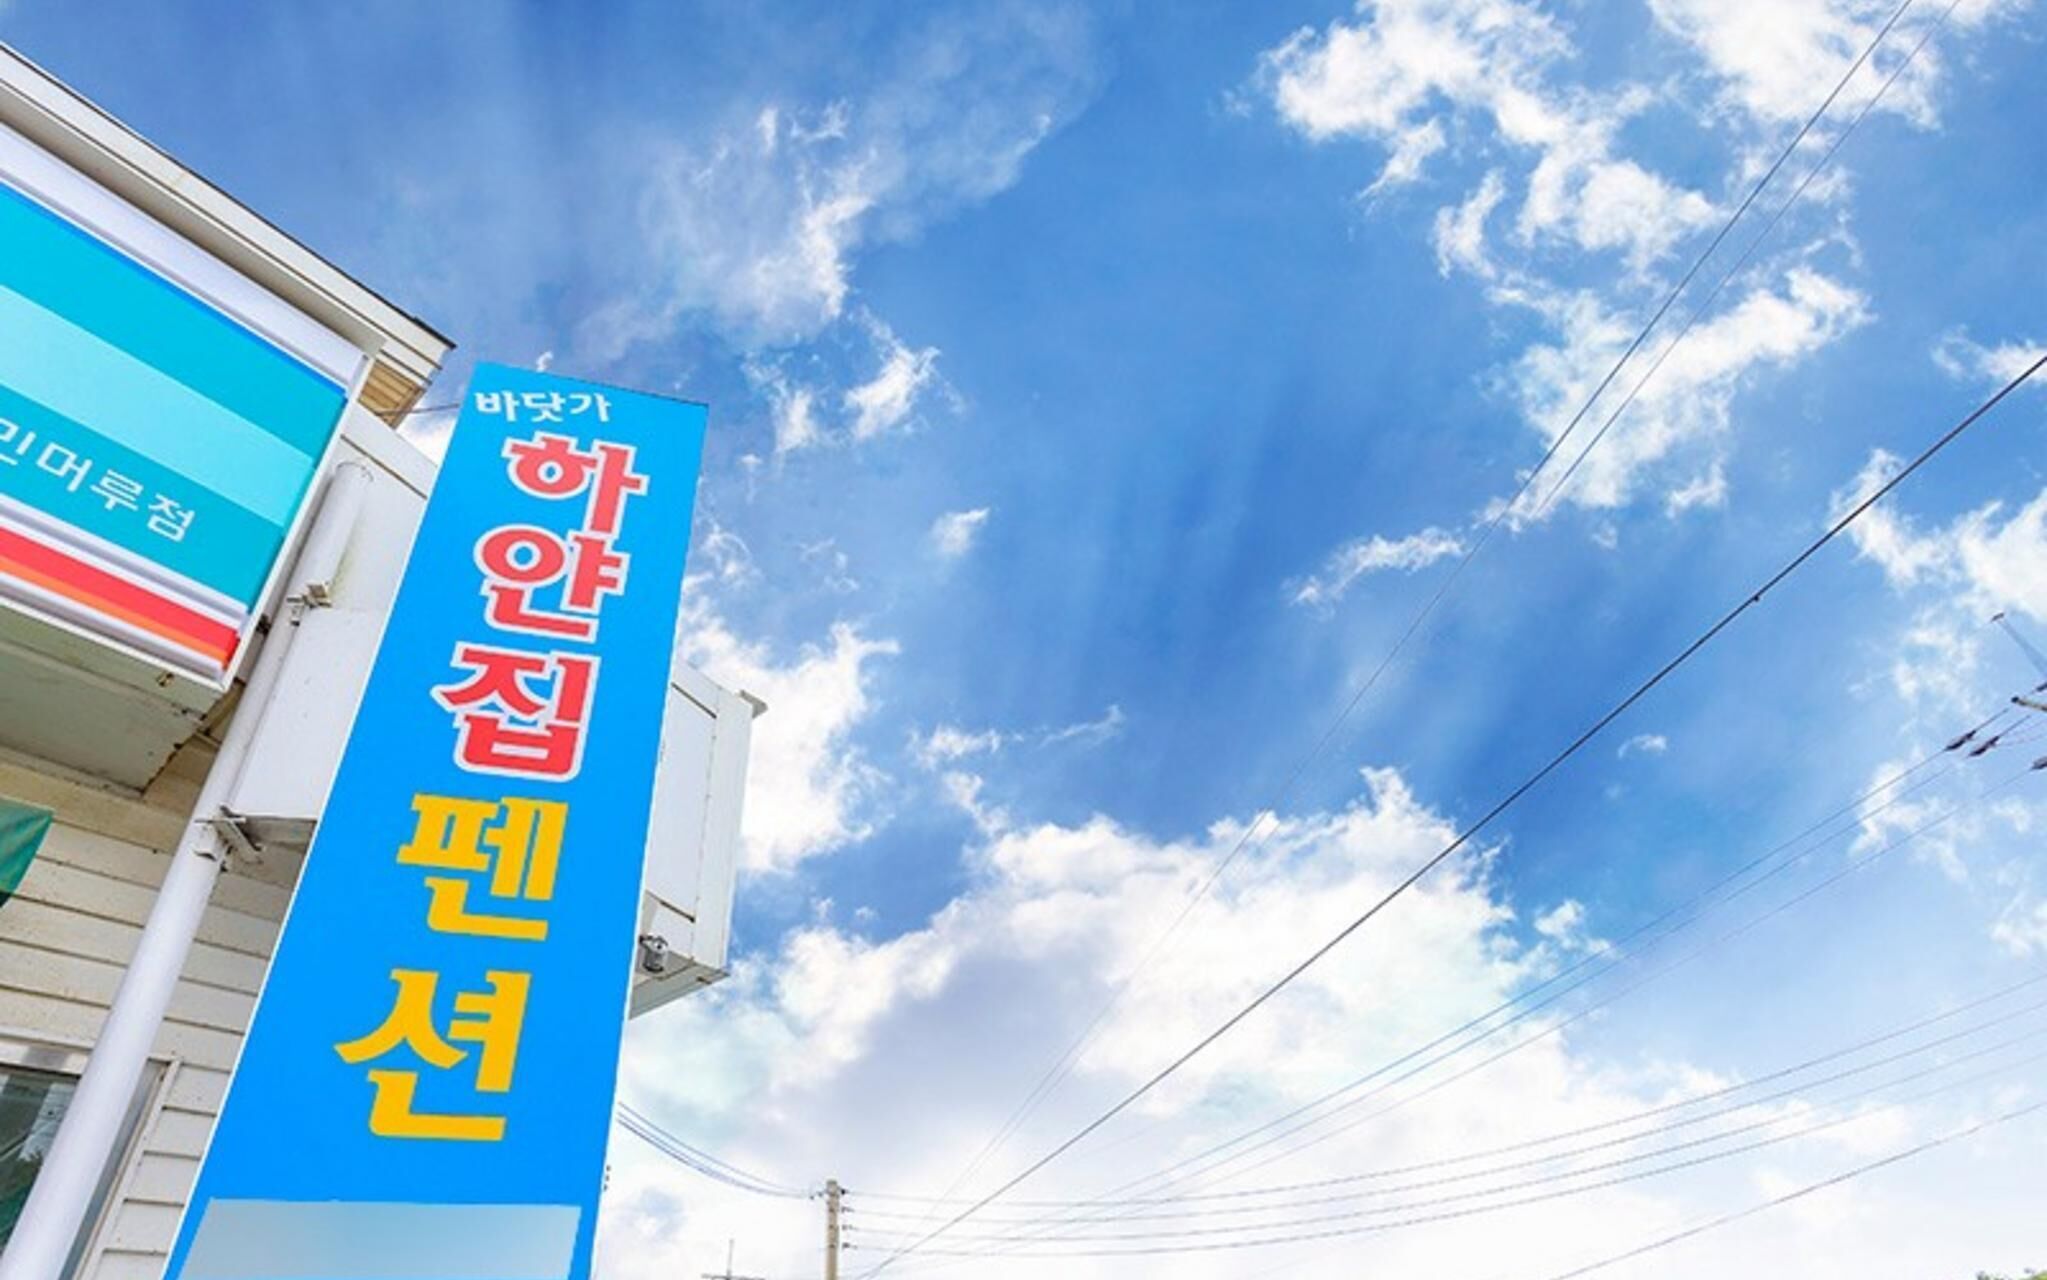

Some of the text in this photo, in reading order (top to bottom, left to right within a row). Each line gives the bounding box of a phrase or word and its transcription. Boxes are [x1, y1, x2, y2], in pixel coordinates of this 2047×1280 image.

[473, 390, 612, 422] 바닷가
[333, 430, 650, 1141] 하얀집 펜션
